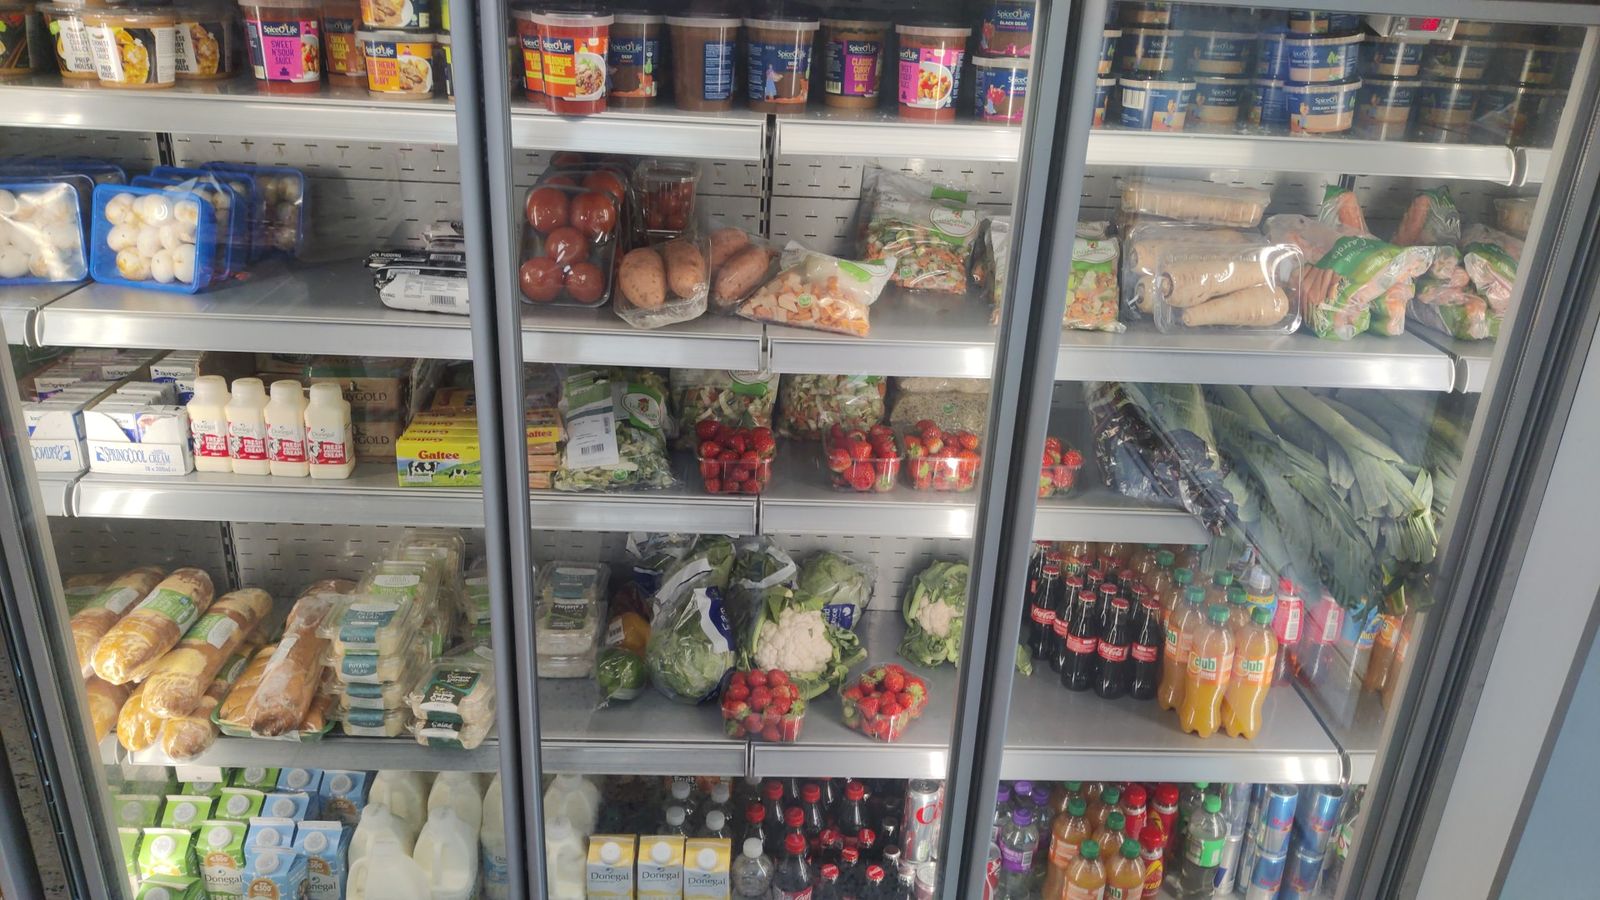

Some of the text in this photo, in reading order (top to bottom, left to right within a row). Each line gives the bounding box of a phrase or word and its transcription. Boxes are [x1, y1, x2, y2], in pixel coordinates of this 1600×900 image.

[271, 40, 293, 48] SWEET
[418, 450, 460, 460] Galtee
[1194, 656, 1216, 671] club
[1241, 659, 1264, 672] club
[204, 873, 242, 884] Donegal
[591, 872, 629, 882] Donegal
[642, 871, 680, 881] Donegal
[688, 877, 726, 886] Donegal
